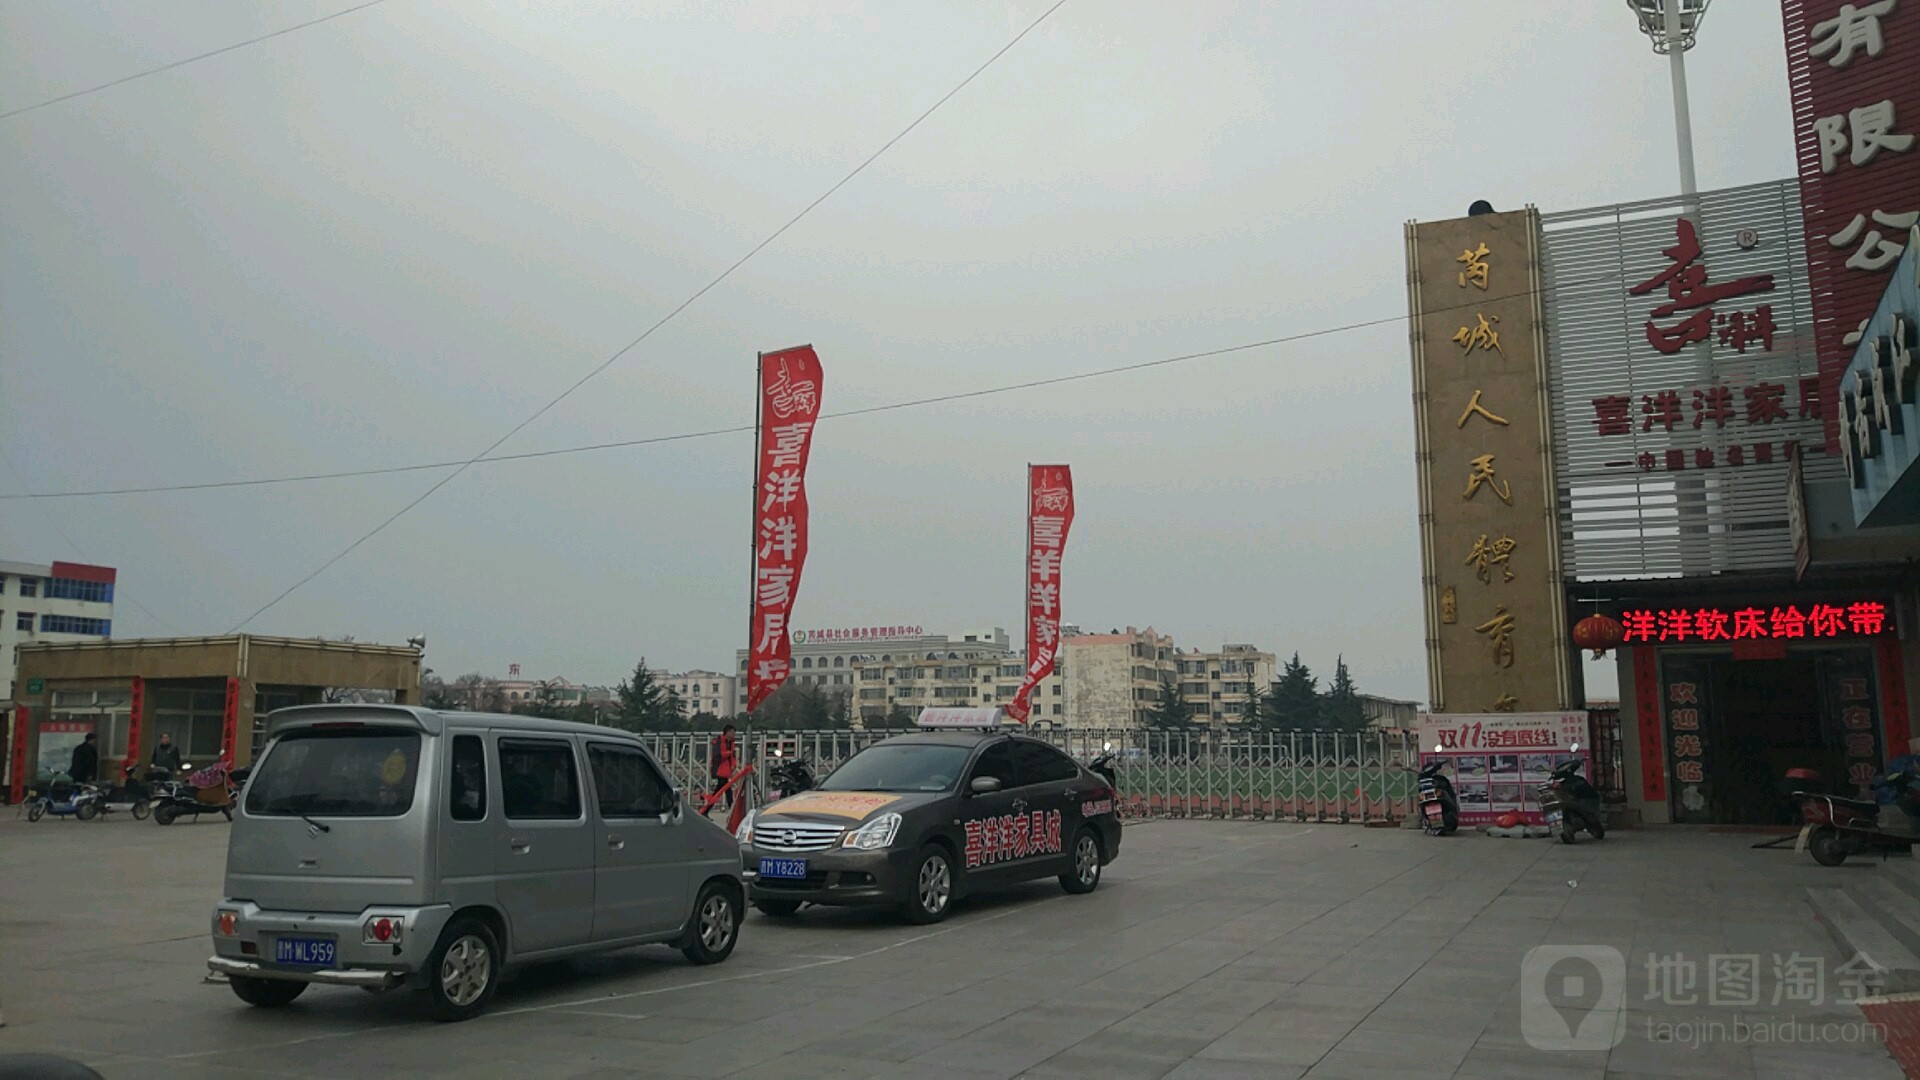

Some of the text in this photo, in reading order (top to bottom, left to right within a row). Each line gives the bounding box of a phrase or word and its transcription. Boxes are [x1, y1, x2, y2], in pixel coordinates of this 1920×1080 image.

[1809, 0, 1920, 346] 有限公
[1622, 602, 1886, 642] 洋洋软床给你带
[1670, 681, 1704, 784] 欢迎光临
[1840, 677, 1877, 785] 正在营业
[964, 809, 1063, 869] 喜洋洋家具城
